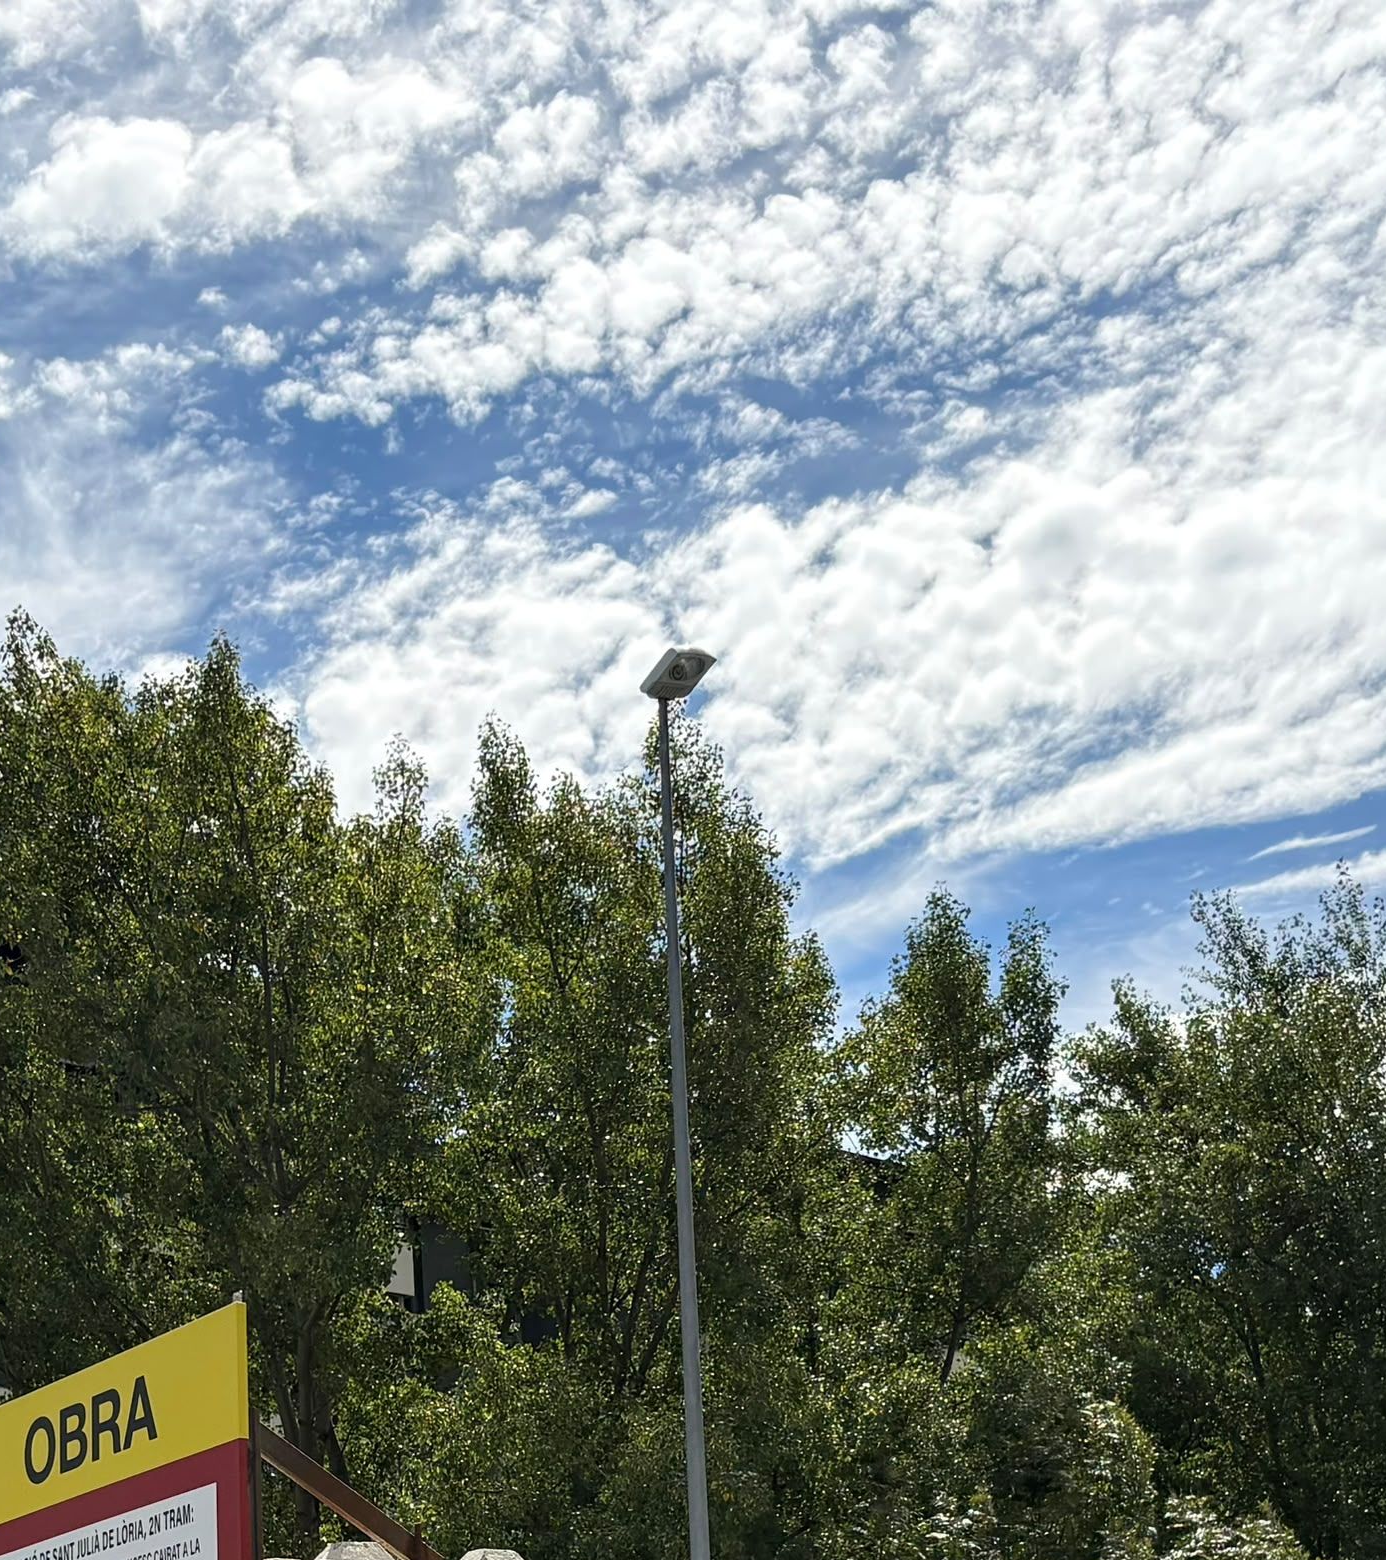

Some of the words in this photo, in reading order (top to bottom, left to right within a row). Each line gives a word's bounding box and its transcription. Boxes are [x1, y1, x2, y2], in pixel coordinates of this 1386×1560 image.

[24, 1375, 158, 1485] OBRA
[77, 1531, 100, 1560] JULIÀ
[103, 1530, 114, 1550] DE
[116, 1520, 147, 1546] LÒRIA,
[149, 1516, 161, 1536] 2N
[163, 1504, 194, 1532] TRAM:
[182, 1541, 188, 1557] A
[190, 1538, 200, 1556] LA
